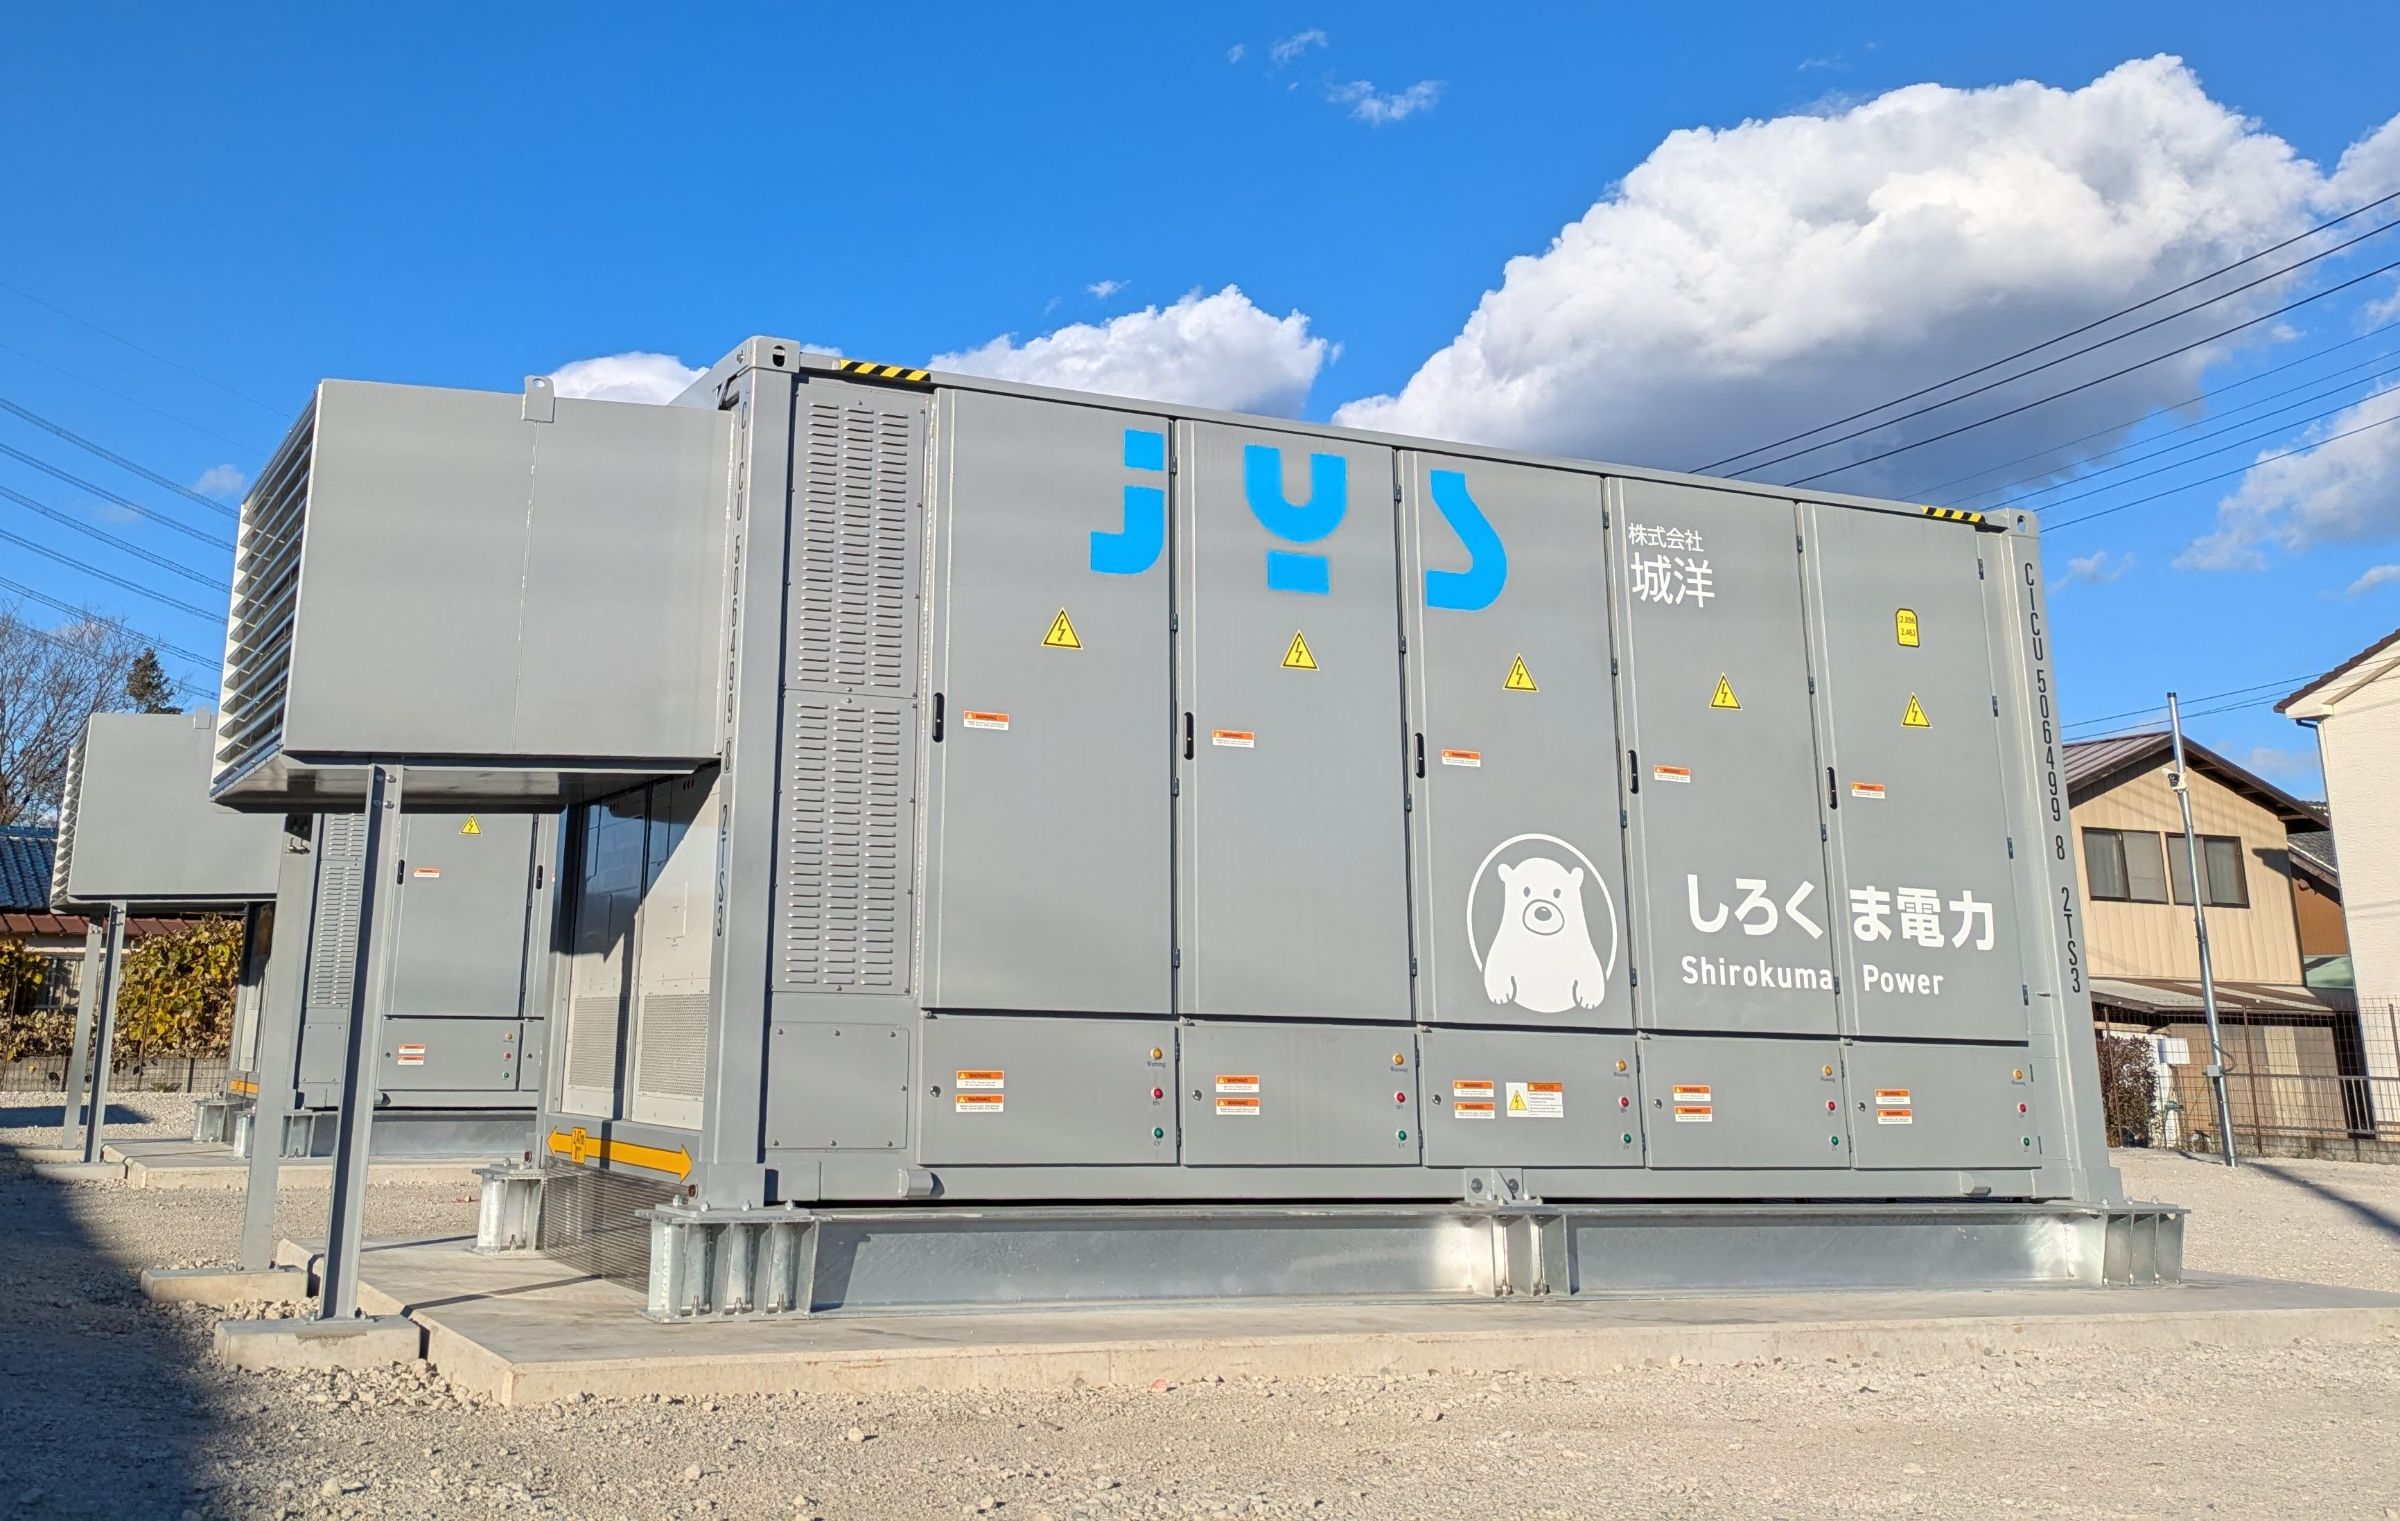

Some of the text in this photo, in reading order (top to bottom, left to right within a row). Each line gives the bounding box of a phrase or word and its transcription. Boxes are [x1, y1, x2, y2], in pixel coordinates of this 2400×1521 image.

[1628, 522, 1704, 552] 株式会社
[1630, 552, 1715, 608] 城洋
[717, 400, 748, 937] CICU 5064499 8 2TS3
[2025, 562, 2081, 993] CICU 5064499 8 2TS3
[1687, 873, 1995, 951] しろくま電力
[1681, 955, 1944, 995] Shirokuma Power
